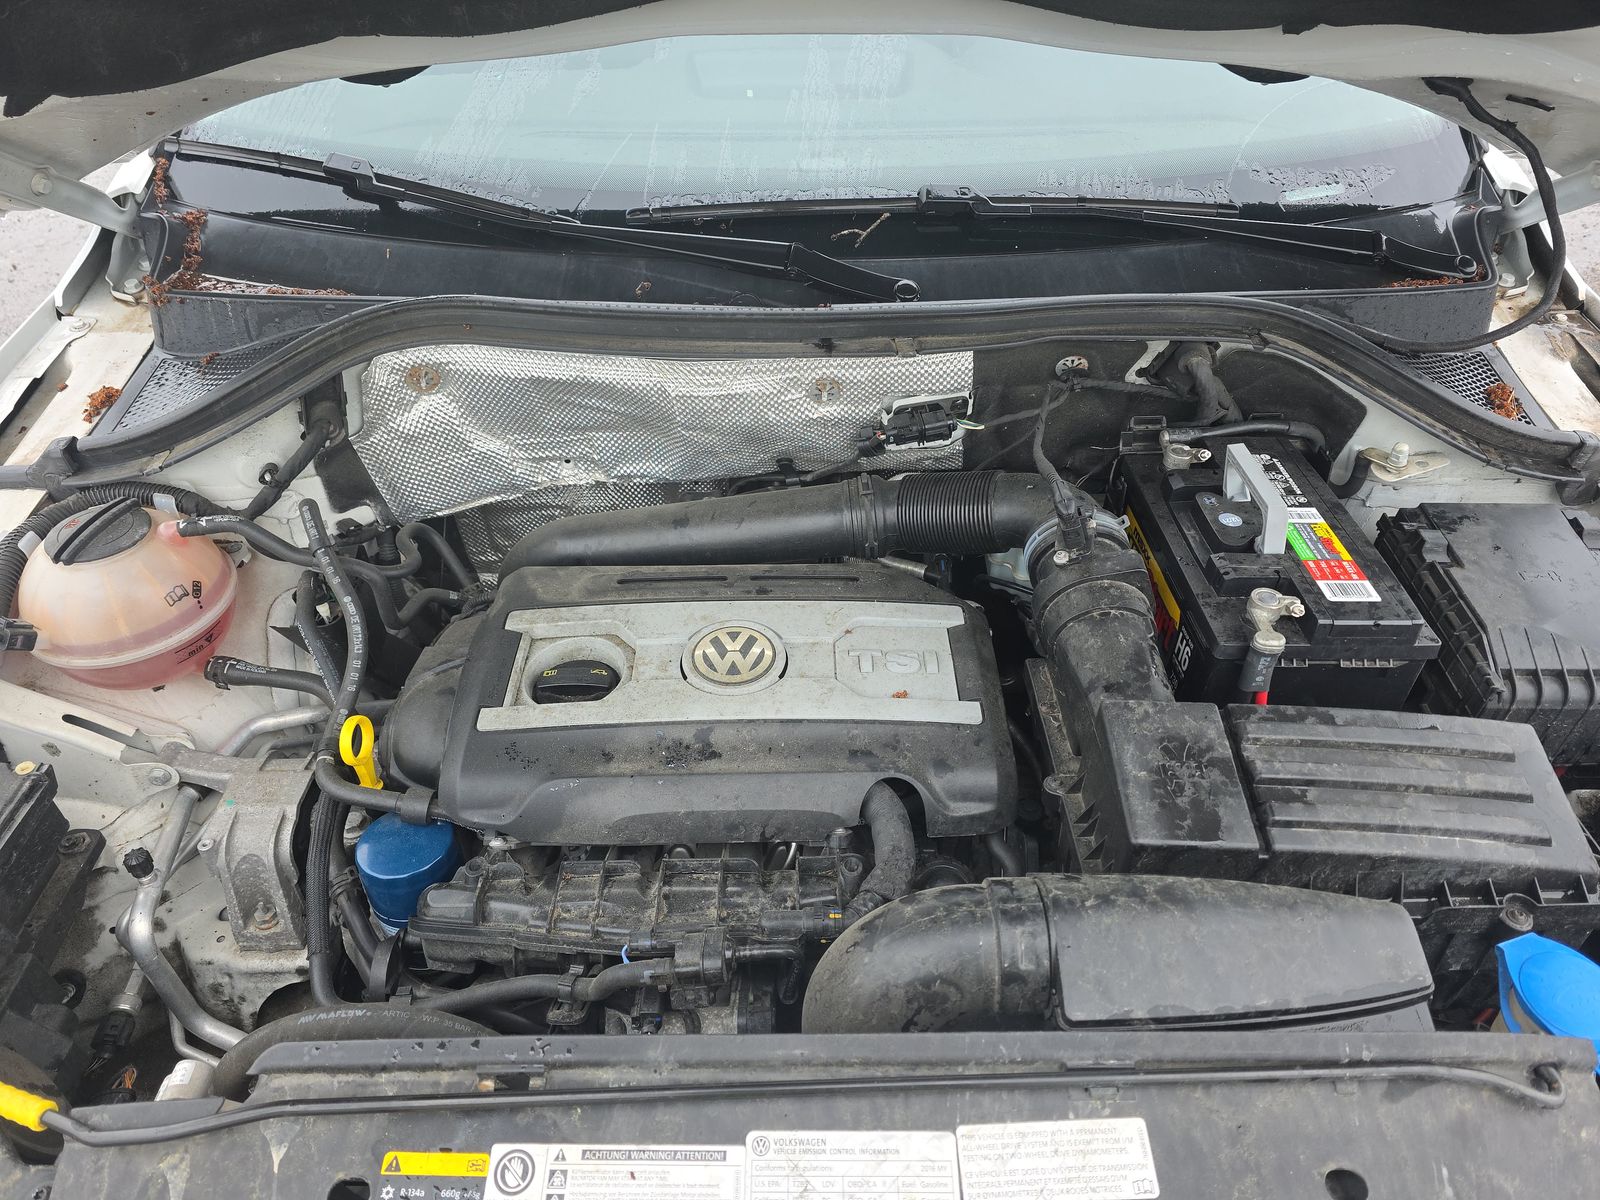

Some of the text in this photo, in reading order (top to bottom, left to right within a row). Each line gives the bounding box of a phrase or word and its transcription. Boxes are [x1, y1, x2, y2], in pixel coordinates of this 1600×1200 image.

[188, 644, 204, 656] min
[1174, 632, 1192, 672] H6
[847, 648, 940, 676] TSI
[382, 1010, 410, 1018] ARTIC
[454, 1022, 472, 1032] BAR
[774, 1138, 826, 1146] VOLKSWAGEN
[584, 1150, 724, 1160] ACHTUNG! WARNING! ATTENTION!
[400, 1188, 425, 1198] R-134a
[440, 1189, 460, 1200] 660g
